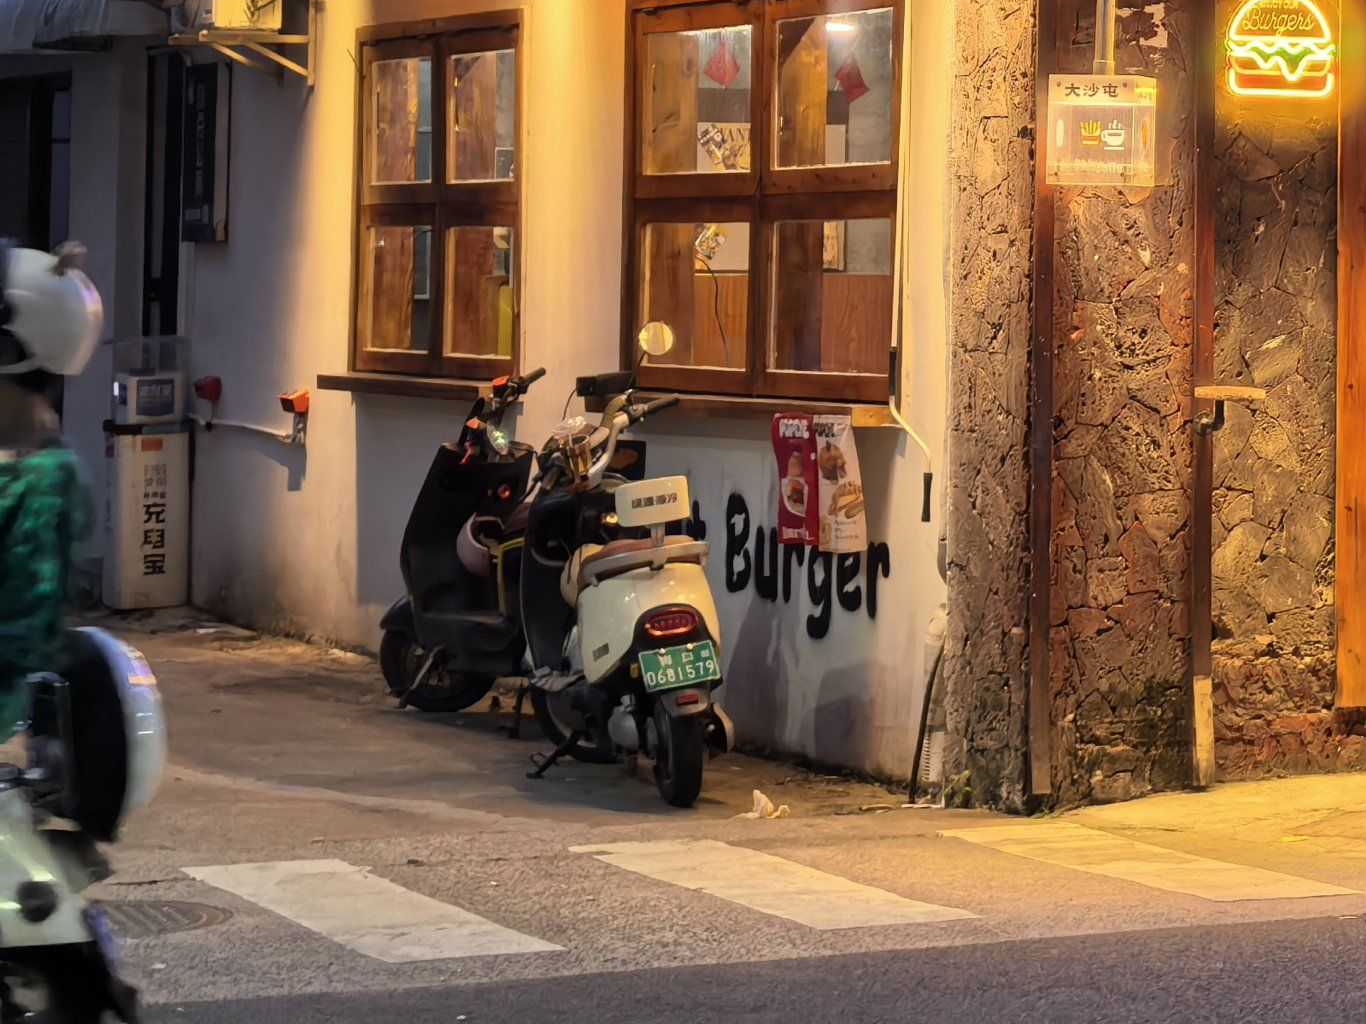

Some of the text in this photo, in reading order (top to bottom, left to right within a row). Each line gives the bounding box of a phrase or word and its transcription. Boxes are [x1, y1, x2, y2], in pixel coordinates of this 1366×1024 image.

[1243, 6, 1315, 37] Burgers
[1064, 83, 1119, 98] 大沙屯
[724, 491, 890, 640] Burger
[646, 660, 715, 686] 0681579
